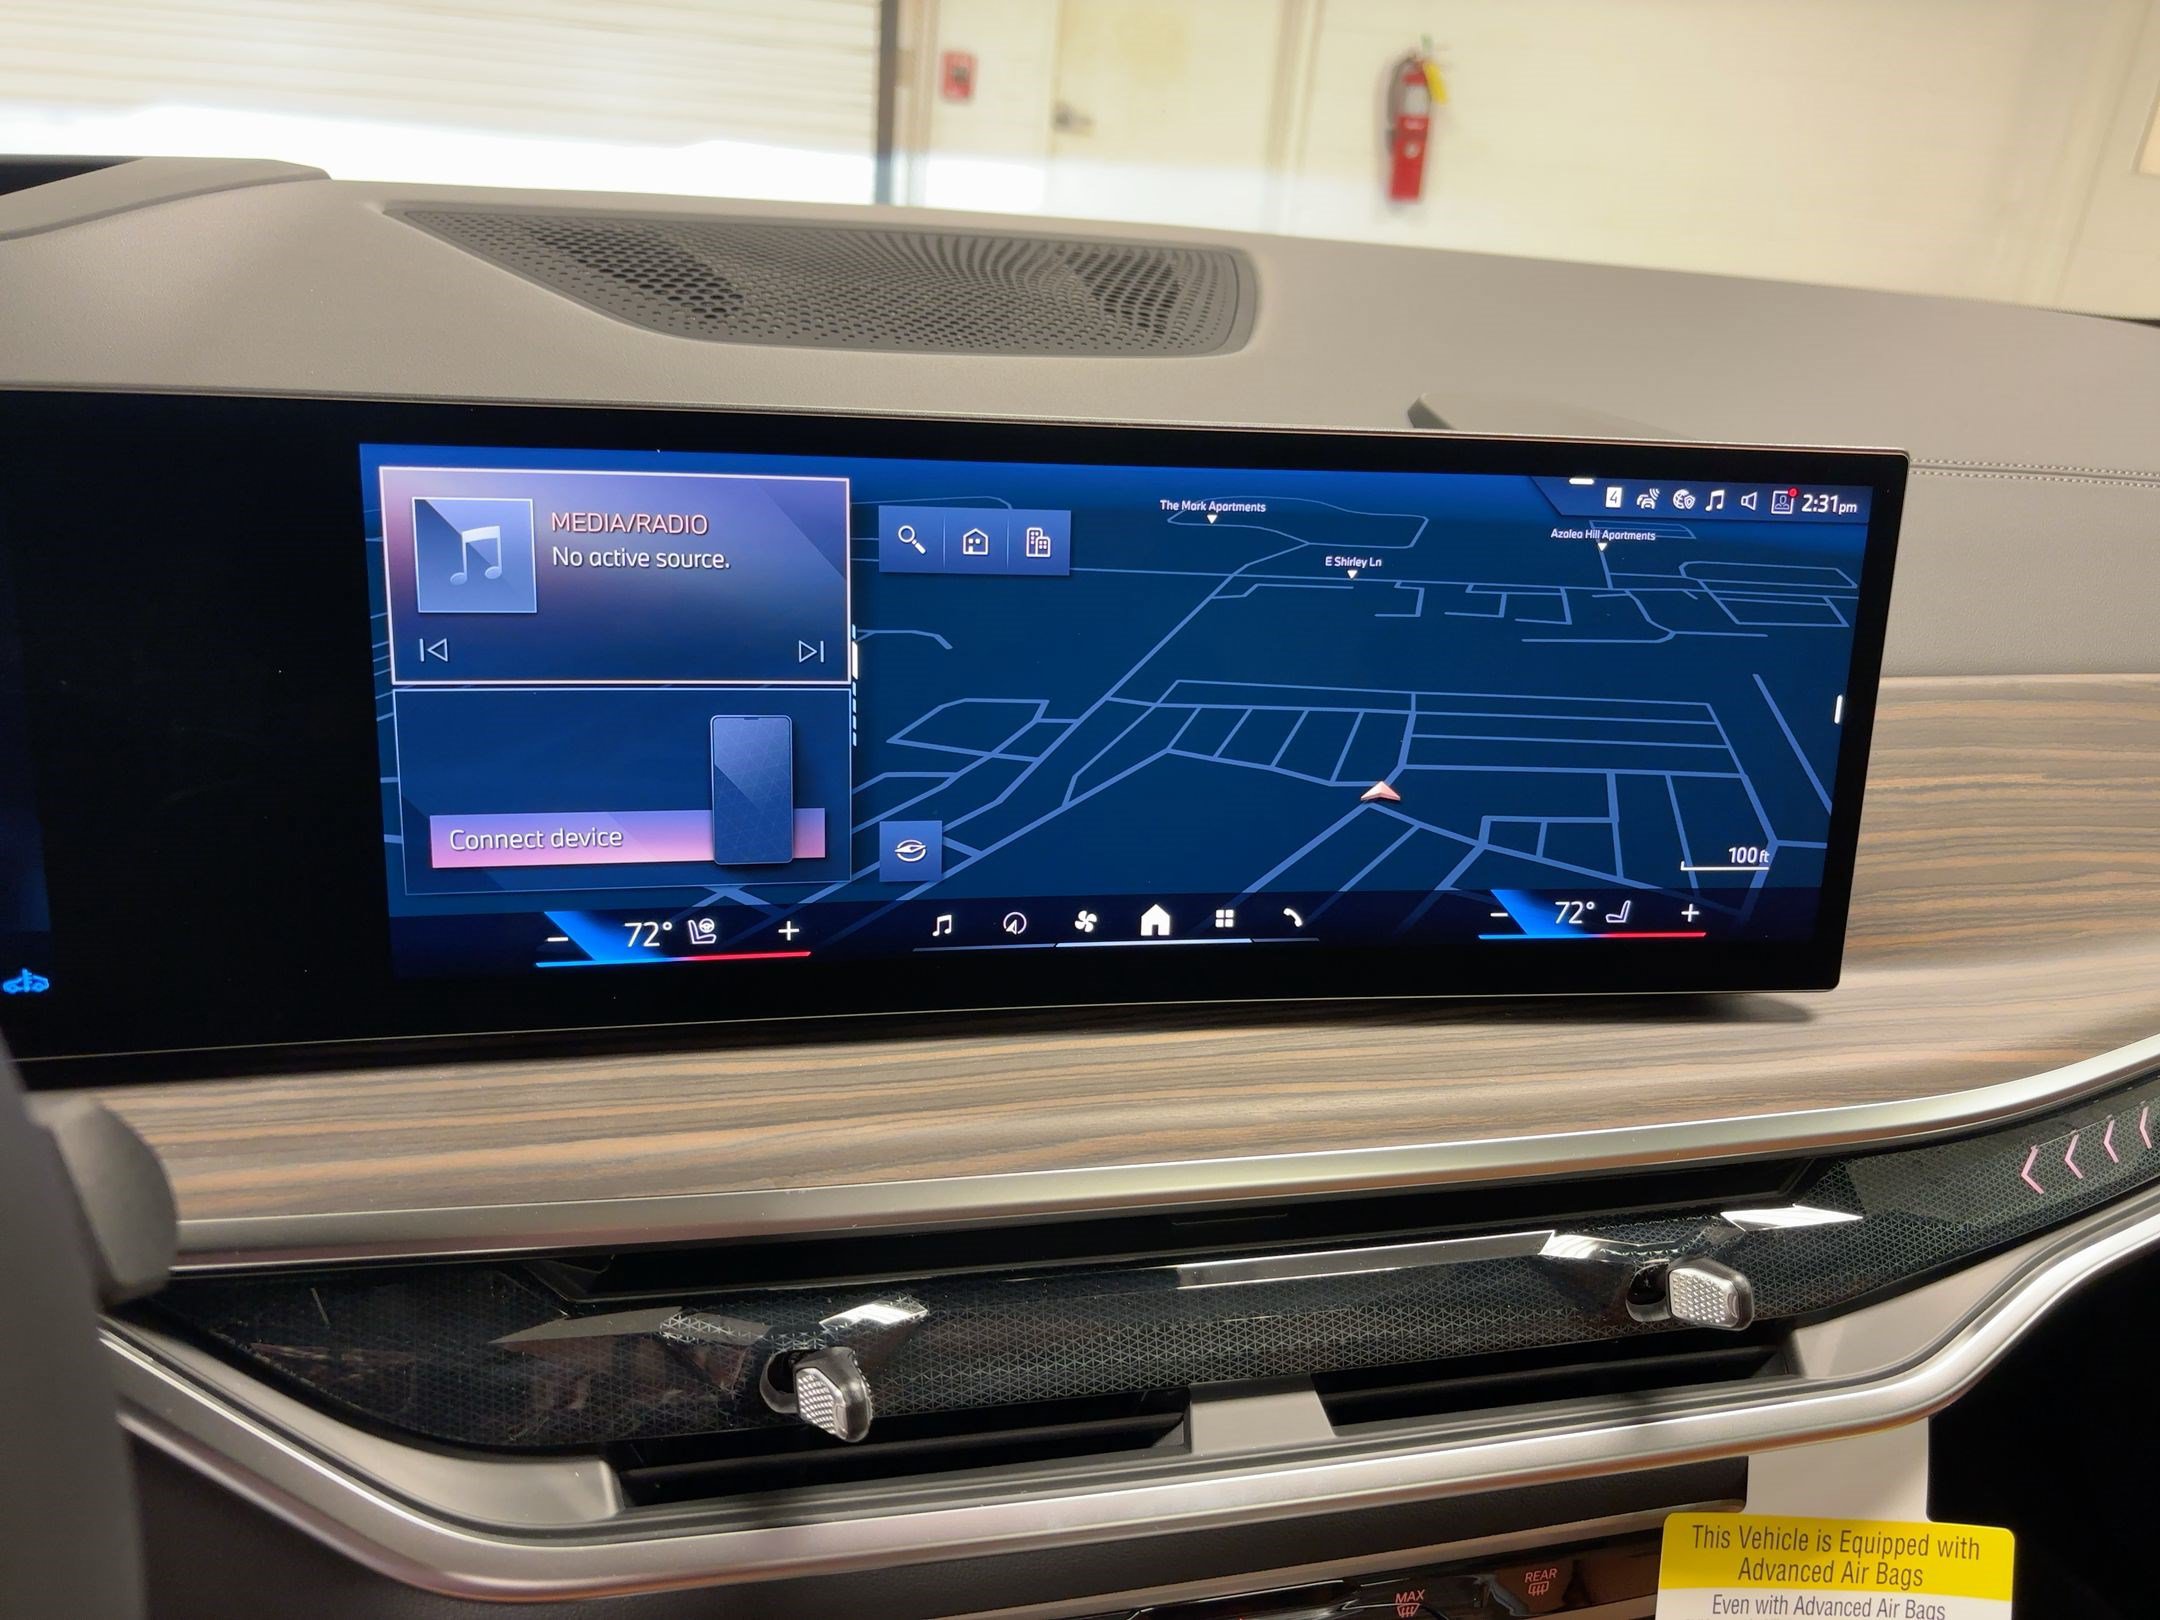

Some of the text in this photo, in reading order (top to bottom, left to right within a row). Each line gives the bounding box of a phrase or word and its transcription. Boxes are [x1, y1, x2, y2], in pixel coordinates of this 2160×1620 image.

[1160, 500, 1266, 513] The Mark Apartments
[551, 512, 708, 535] MEDIA/RADIO
[1550, 528, 1656, 541] Azalea Hill Apartments
[553, 547, 730, 569] No active source.
[1325, 557, 1382, 568] E Shirley Ln
[450, 827, 623, 850] Connect device
[1692, 1525, 1980, 1560] This Vehicle is Equipped with
[1524, 1568, 1557, 1583] REAR
[1738, 1557, 1923, 1591] Advanced Air Bags
[1395, 1589, 1425, 1604] MAX
[1712, 1594, 1945, 1620] Even with Advanced Air Bags
